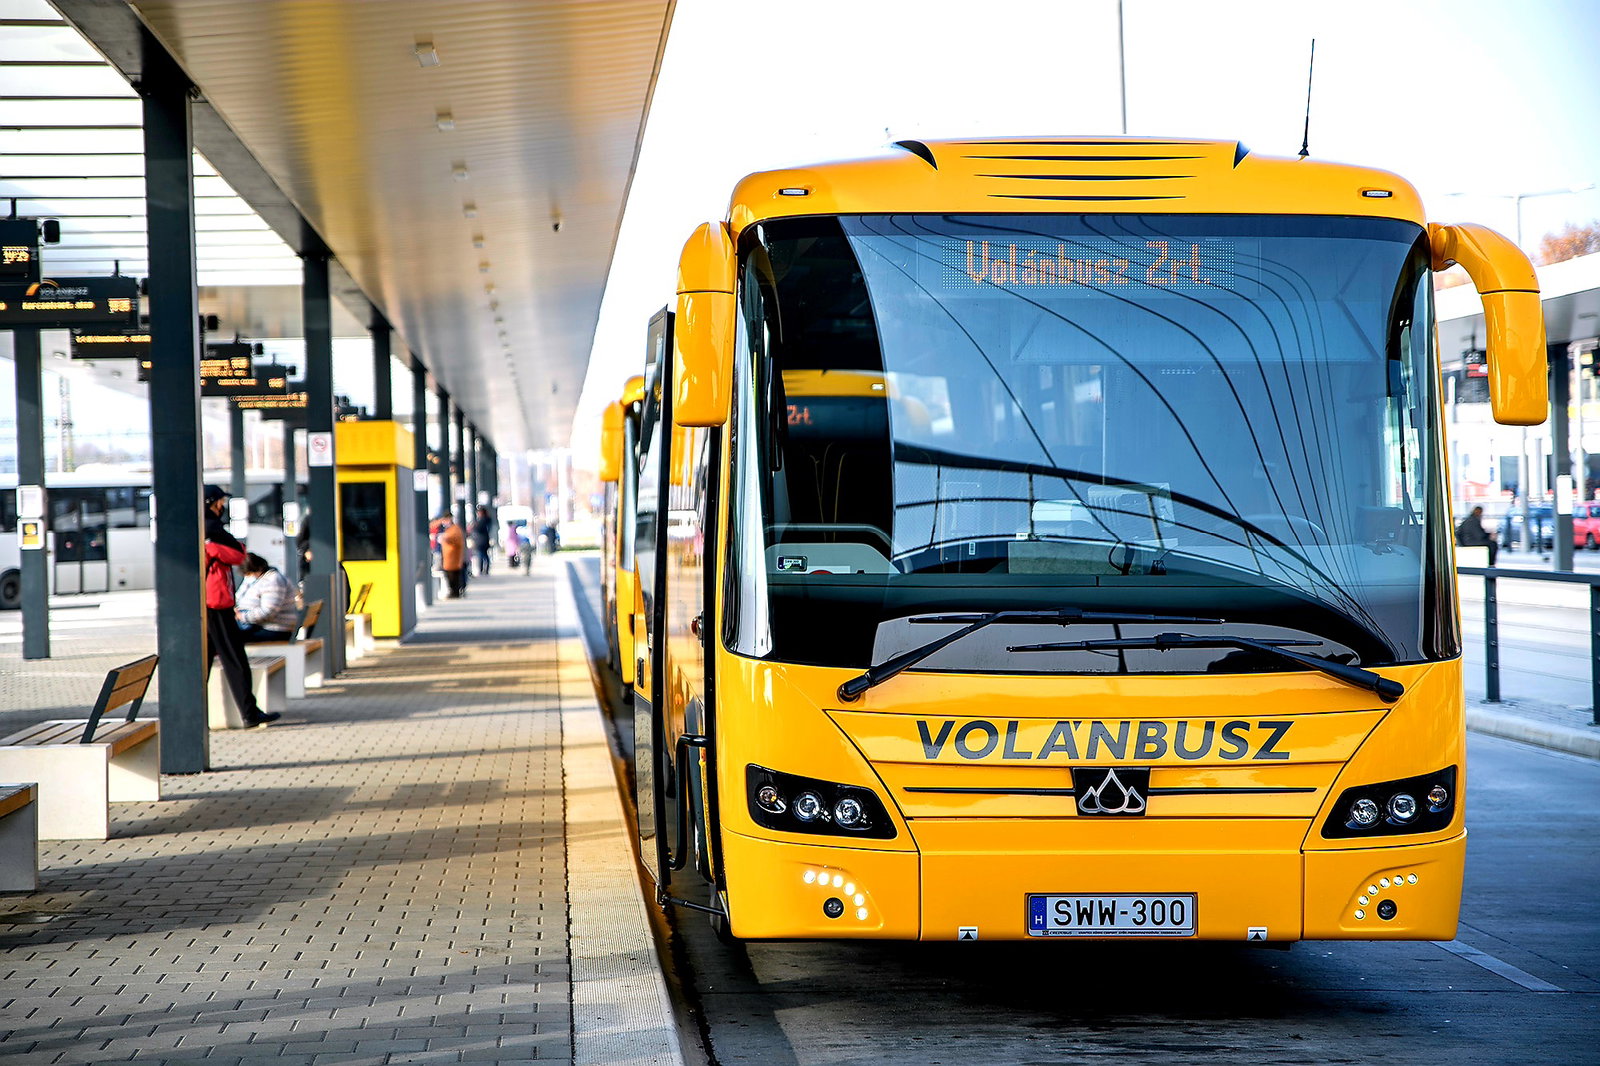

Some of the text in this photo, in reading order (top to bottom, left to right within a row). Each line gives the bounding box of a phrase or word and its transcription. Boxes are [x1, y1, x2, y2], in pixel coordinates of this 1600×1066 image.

[965, 241, 1129, 284] Volánbusz
[915, 720, 1295, 760] VOLÁNBUSZ
[1034, 915, 1043, 925] H
[1053, 900, 1186, 926] SWW-300
